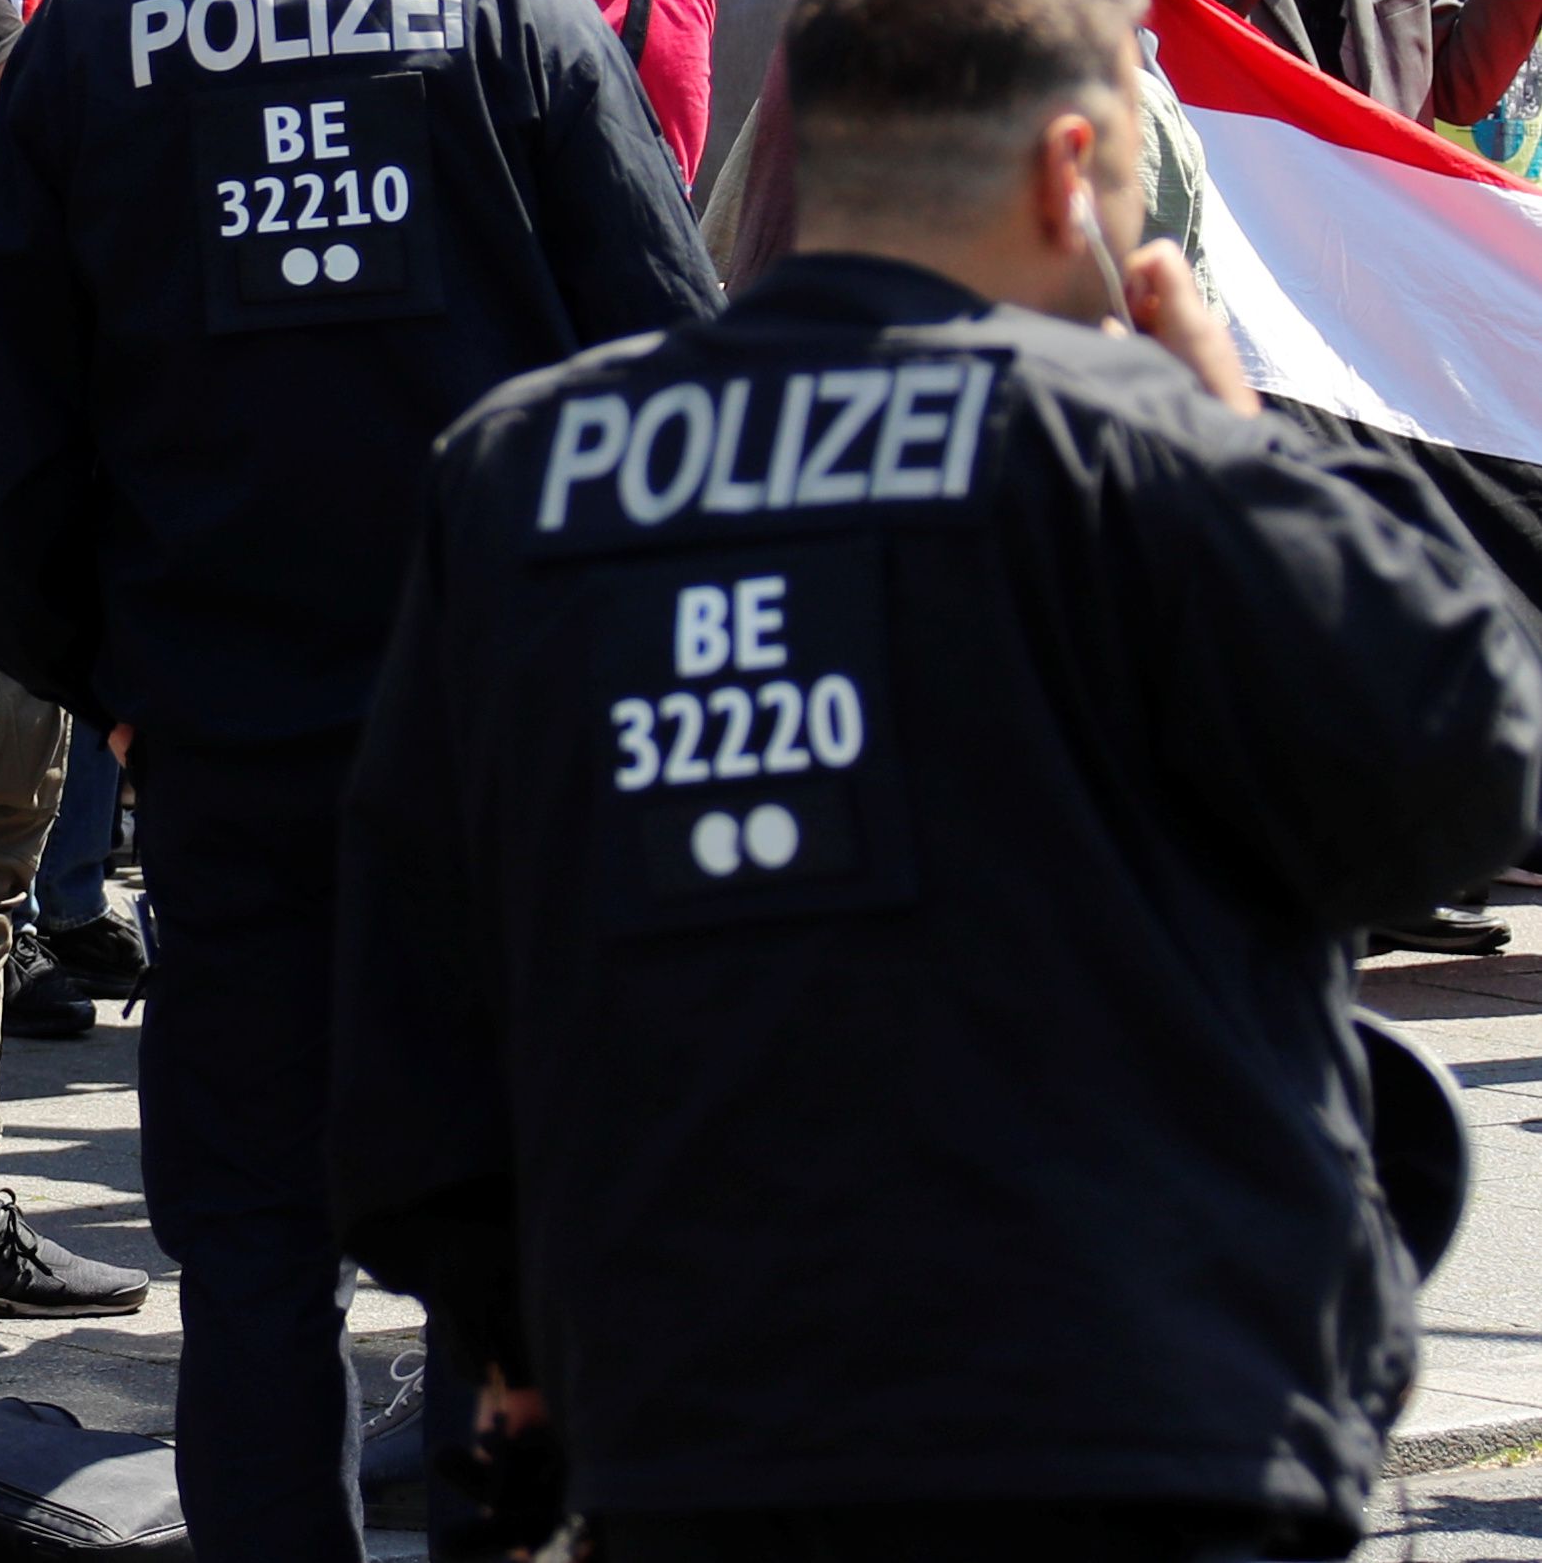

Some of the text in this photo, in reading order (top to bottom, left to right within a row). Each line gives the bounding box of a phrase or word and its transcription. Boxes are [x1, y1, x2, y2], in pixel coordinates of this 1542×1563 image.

[263, 101, 349, 164] BE
[217, 166, 409, 237] 32210
[537, 361, 995, 532] POLIZEI
[675, 576, 788, 678] BE
[611, 674, 864, 791] 32220
